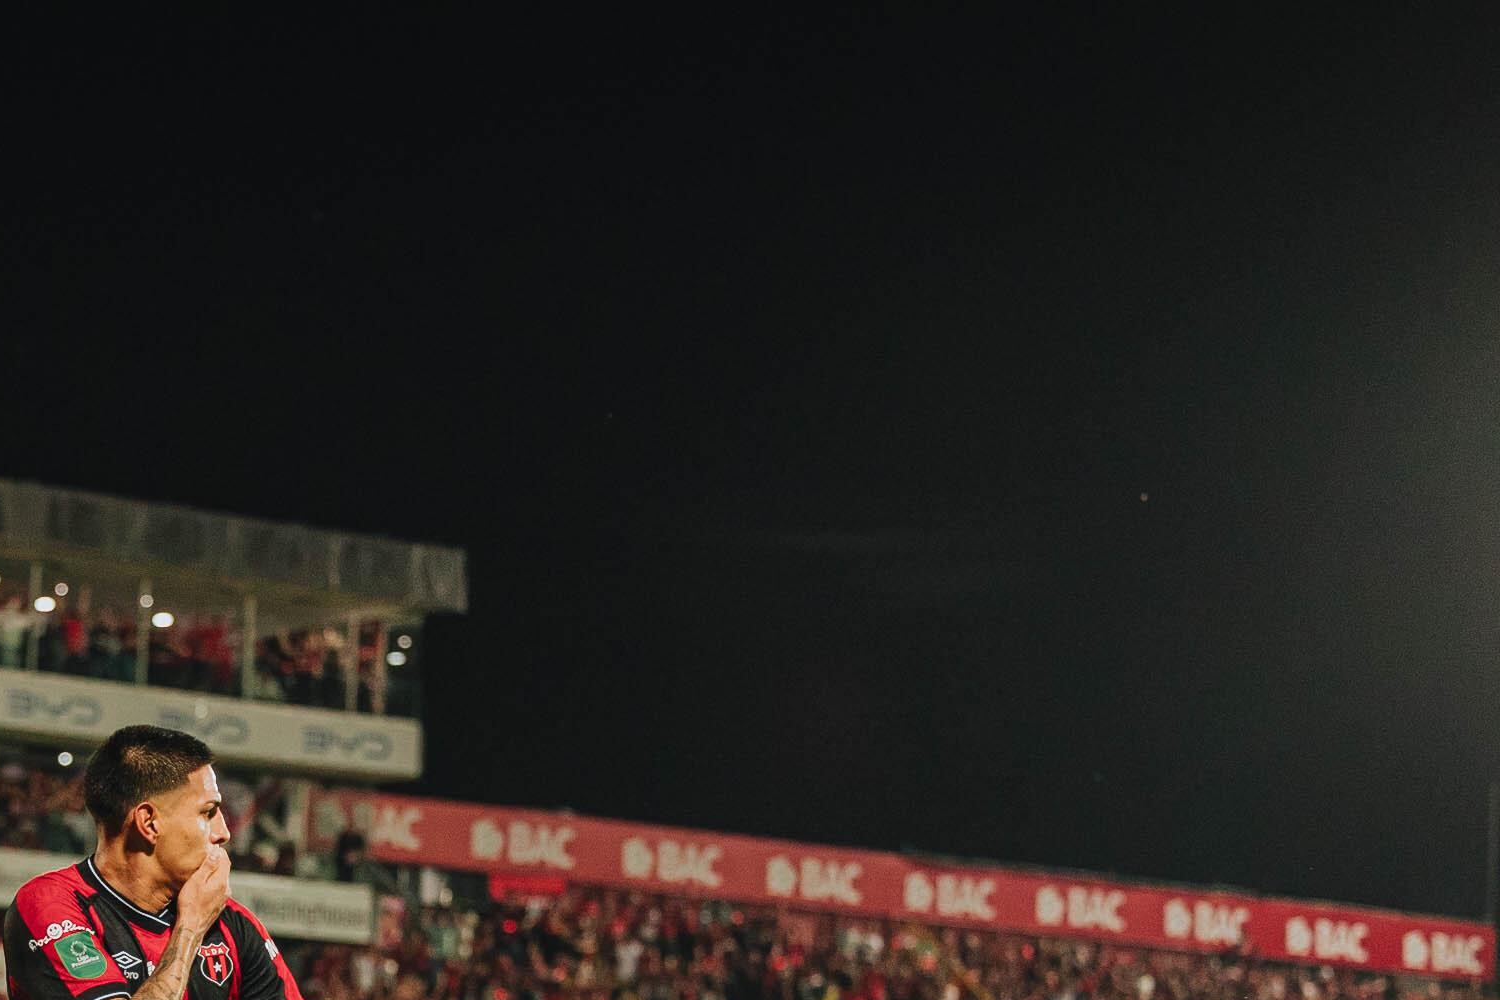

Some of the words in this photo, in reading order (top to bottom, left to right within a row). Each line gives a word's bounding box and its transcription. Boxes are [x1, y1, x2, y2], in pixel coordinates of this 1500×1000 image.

[507, 820, 574, 870] BAC
[656, 841, 721, 887] BAC
[801, 859, 863, 906] BAC
[935, 875, 996, 921] BAC
[1067, 886, 1126, 932] BAC
[204, 947, 224, 957] LDA
[1315, 918, 1369, 963] BAC
[1431, 932, 1485, 976] BAC
